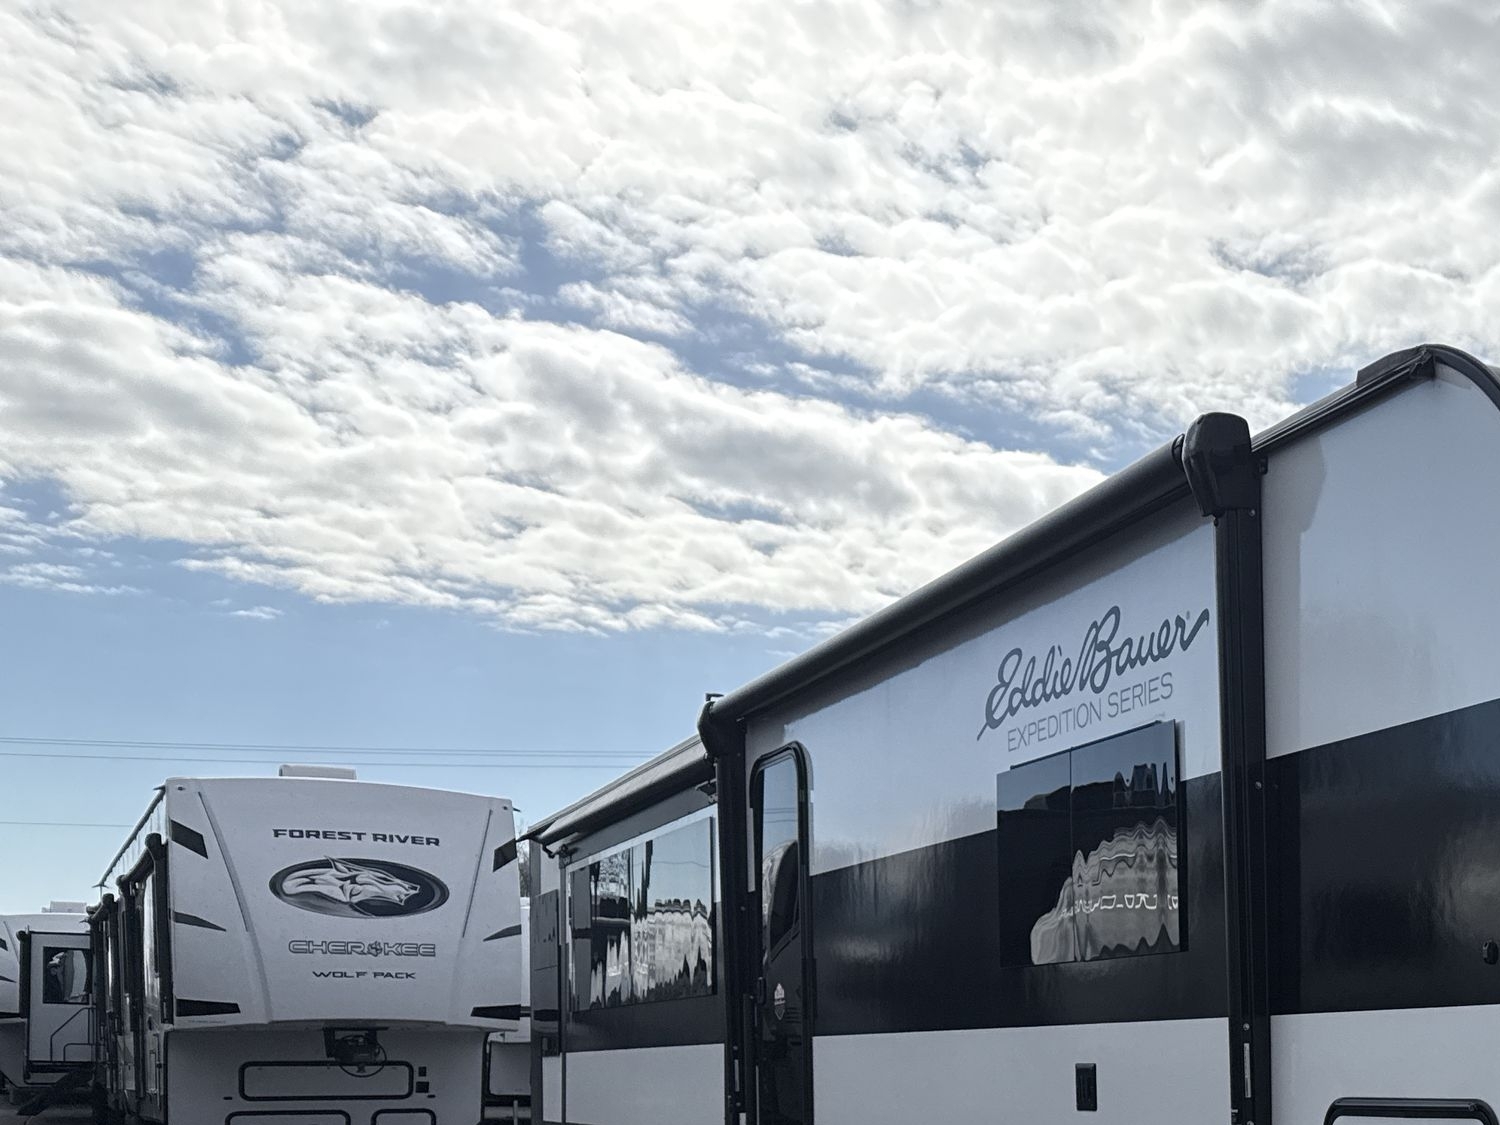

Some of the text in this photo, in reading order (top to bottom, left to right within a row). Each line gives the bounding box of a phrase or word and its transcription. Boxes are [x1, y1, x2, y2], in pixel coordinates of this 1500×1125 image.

[976, 605, 1210, 741] Eddie Bauer
[1007, 671, 1173, 752] EXPEDITION SERIES
[272, 828, 440, 847] FOREST RIVER
[312, 971, 416, 980] WOLF PACK
